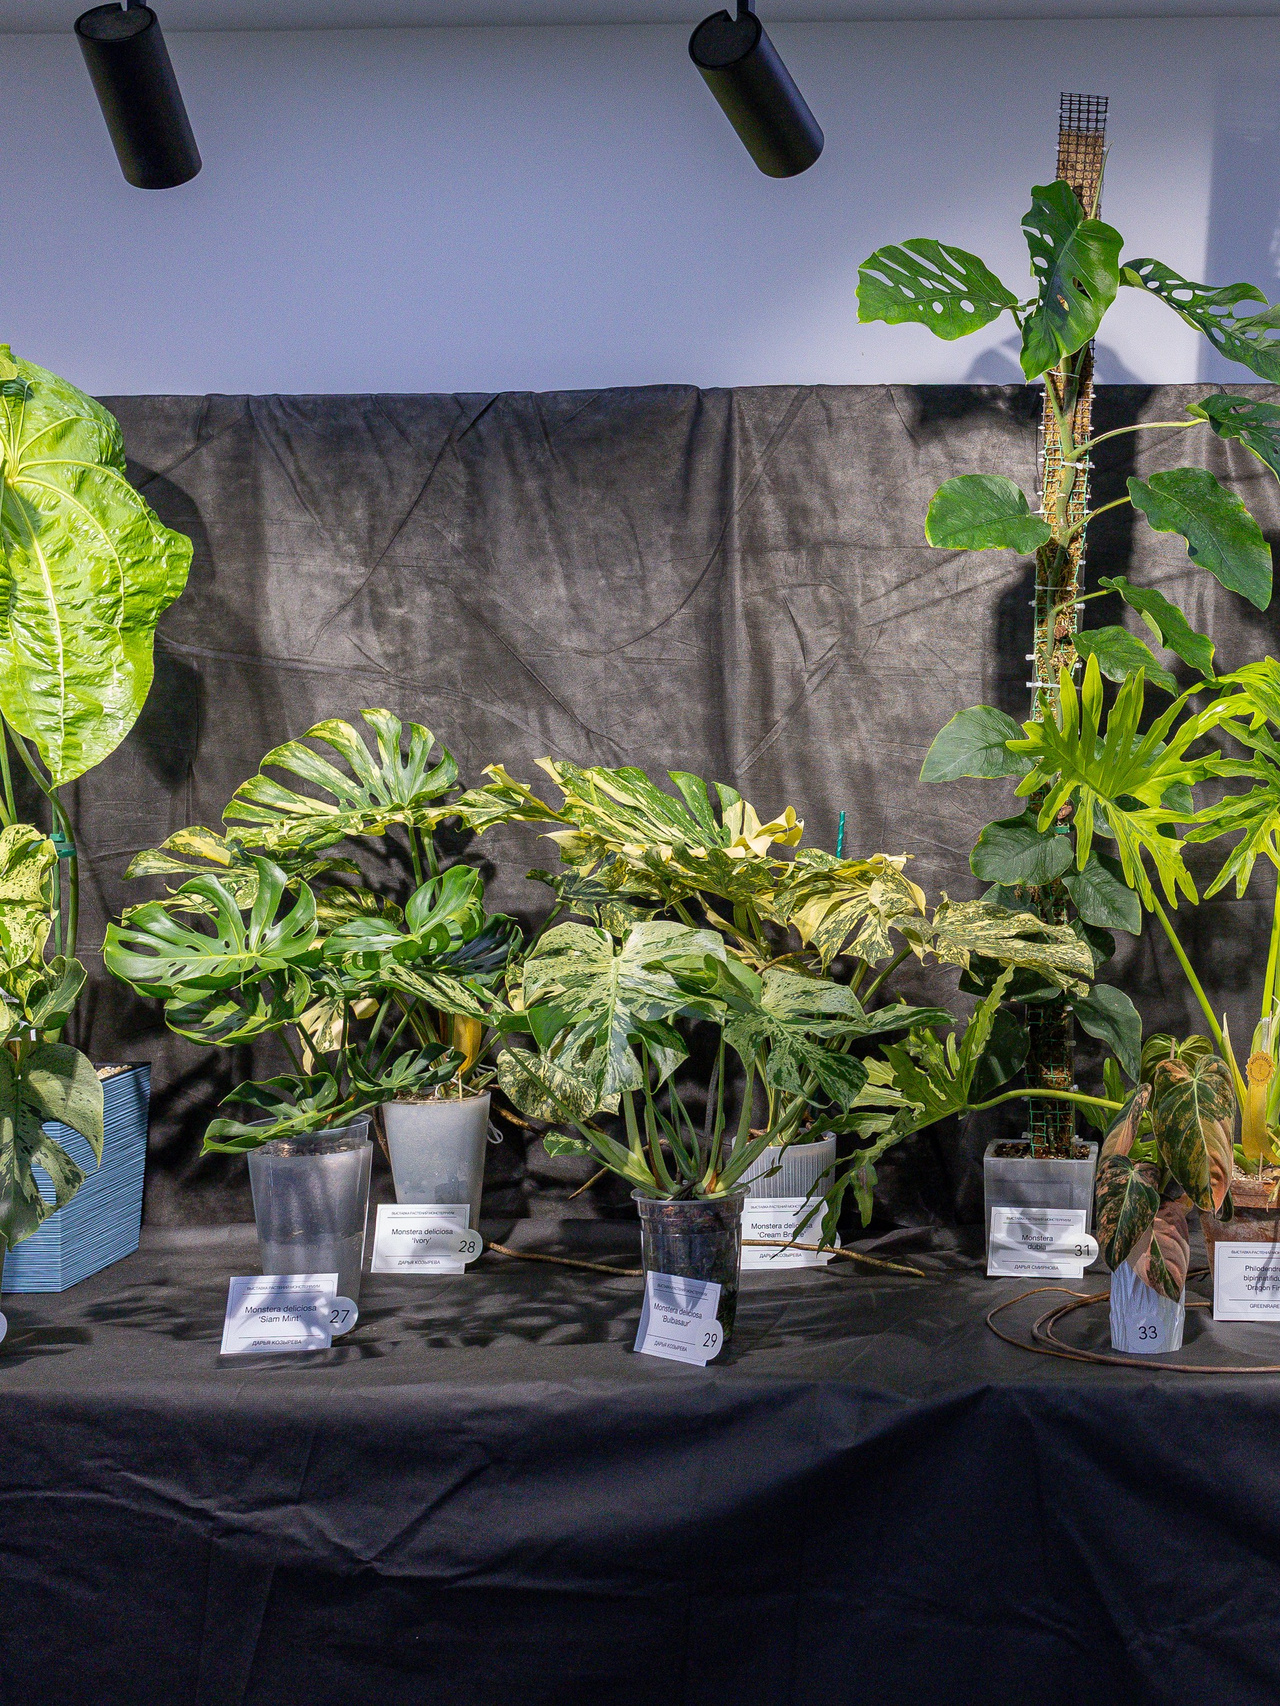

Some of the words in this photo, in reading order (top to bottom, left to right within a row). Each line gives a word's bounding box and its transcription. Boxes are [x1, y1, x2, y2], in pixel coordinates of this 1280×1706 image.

[458, 1240, 476, 1253] 28
[1074, 1244, 1090, 1256] 31
[329, 1310, 350, 1324] 27
[654, 1302, 678, 1314] Monstera
[679, 1308, 702, 1319] deliciosa
[703, 1332, 718, 1348] 29
[1138, 1326, 1157, 1340] 33
